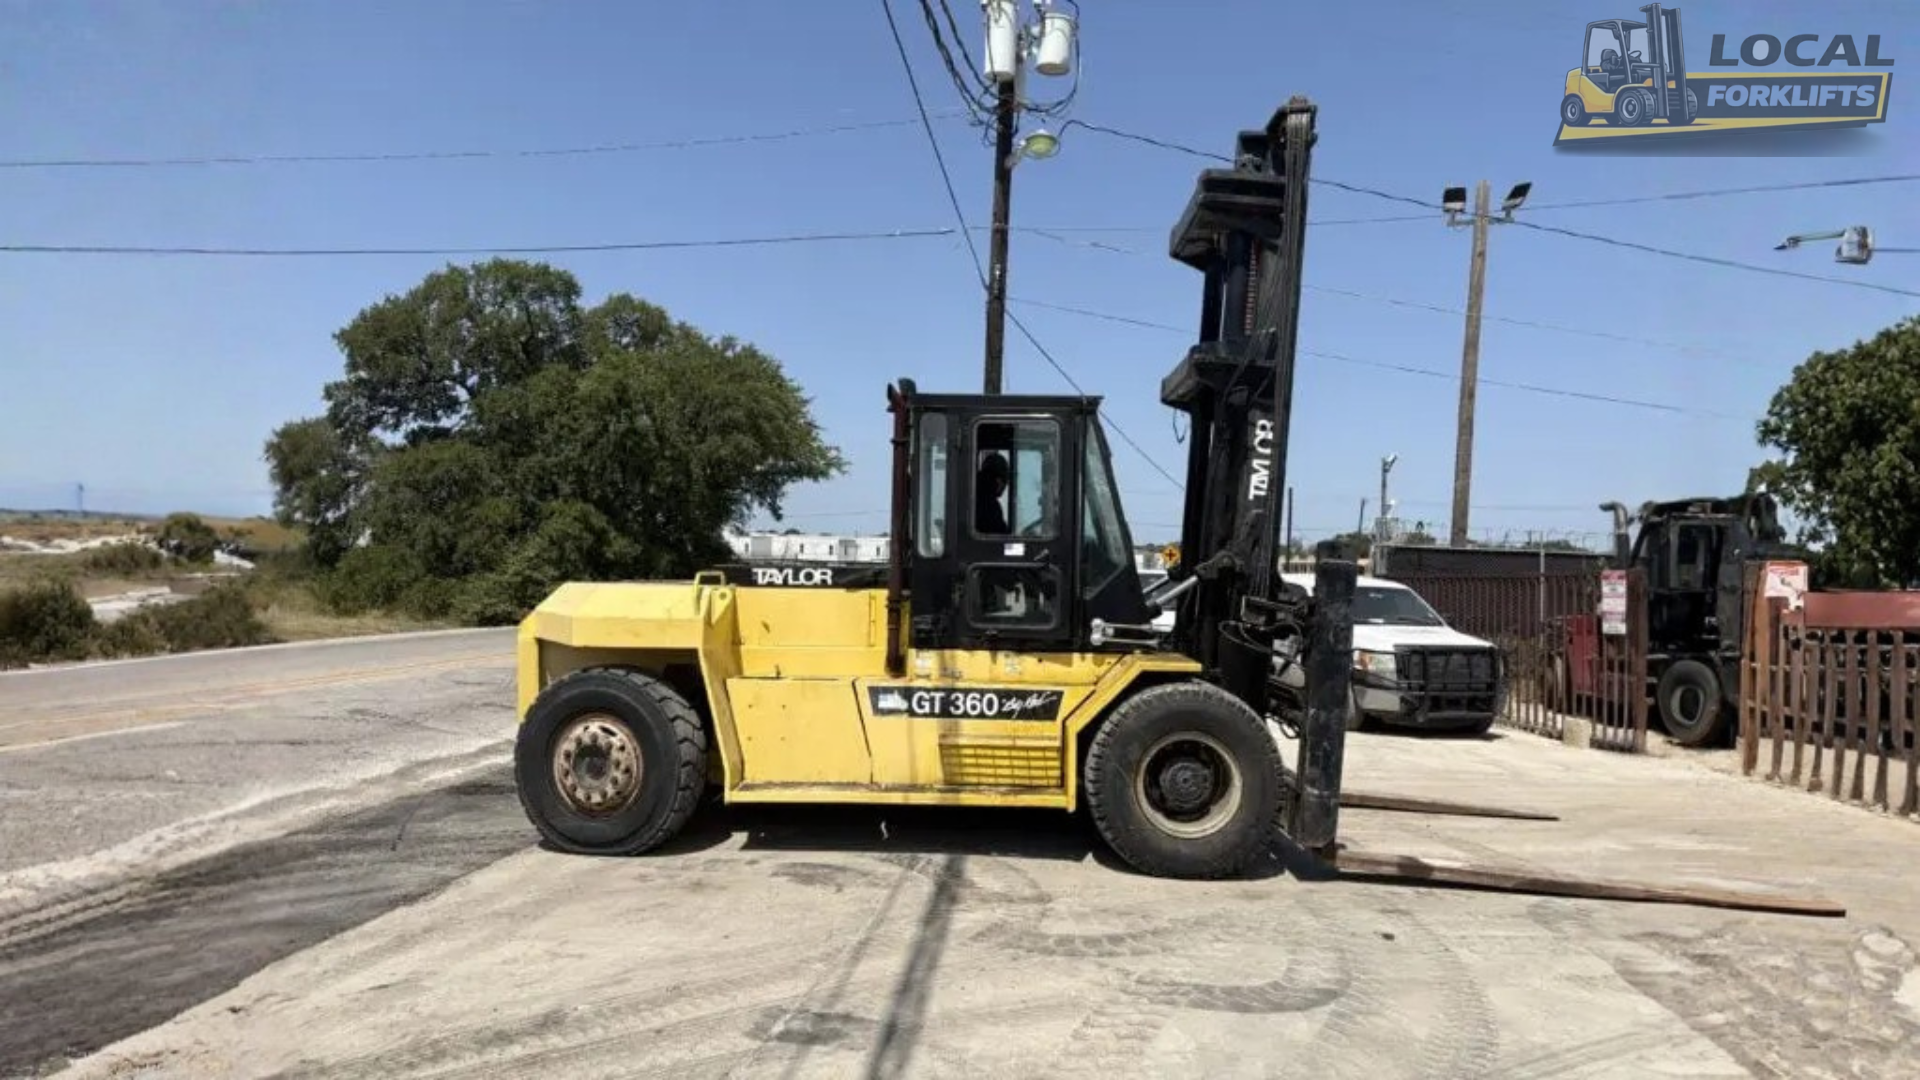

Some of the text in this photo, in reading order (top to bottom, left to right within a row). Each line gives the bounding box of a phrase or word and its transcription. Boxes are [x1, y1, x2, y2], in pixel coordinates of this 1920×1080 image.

[752, 567, 834, 586] TAYLOR
[912, 691, 945, 714] GT
[949, 693, 999, 716] 360
